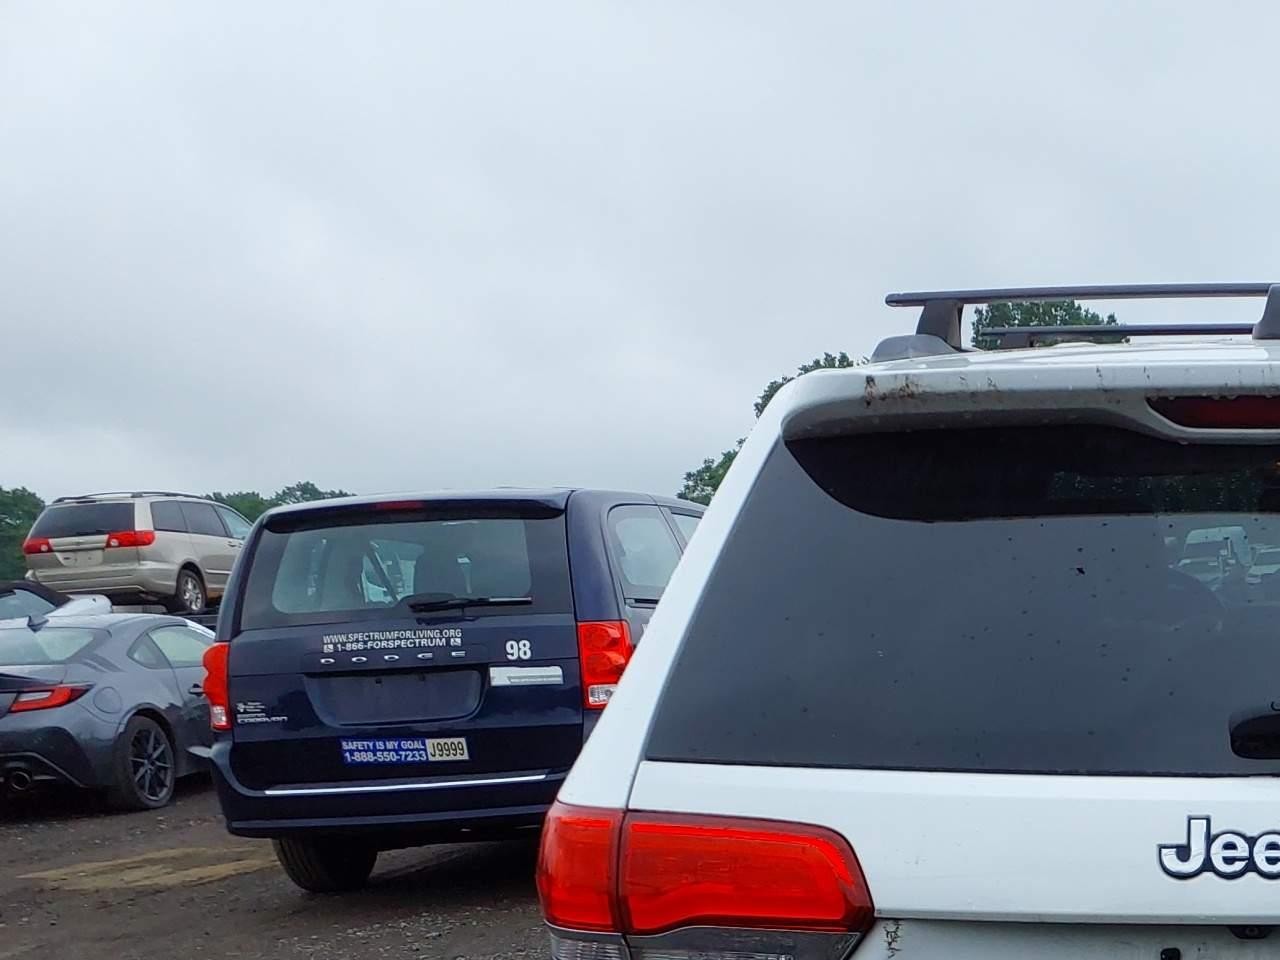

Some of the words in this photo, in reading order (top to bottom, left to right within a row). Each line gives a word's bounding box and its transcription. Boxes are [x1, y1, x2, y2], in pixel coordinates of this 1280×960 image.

[323, 629, 462, 644] WWW.SPECTRUMFORLIVING.ORG
[336, 637, 446, 652] 1-866-FORSPECTRUM
[505, 640, 532, 660] 98
[342, 741, 374, 751] SAFETY
[376, 741, 385, 750] IS
[386, 740, 399, 750] MY
[400, 740, 425, 749] GOAL
[429, 741, 465, 758] J9999
[344, 750, 427, 763] 1-888-550-7233
